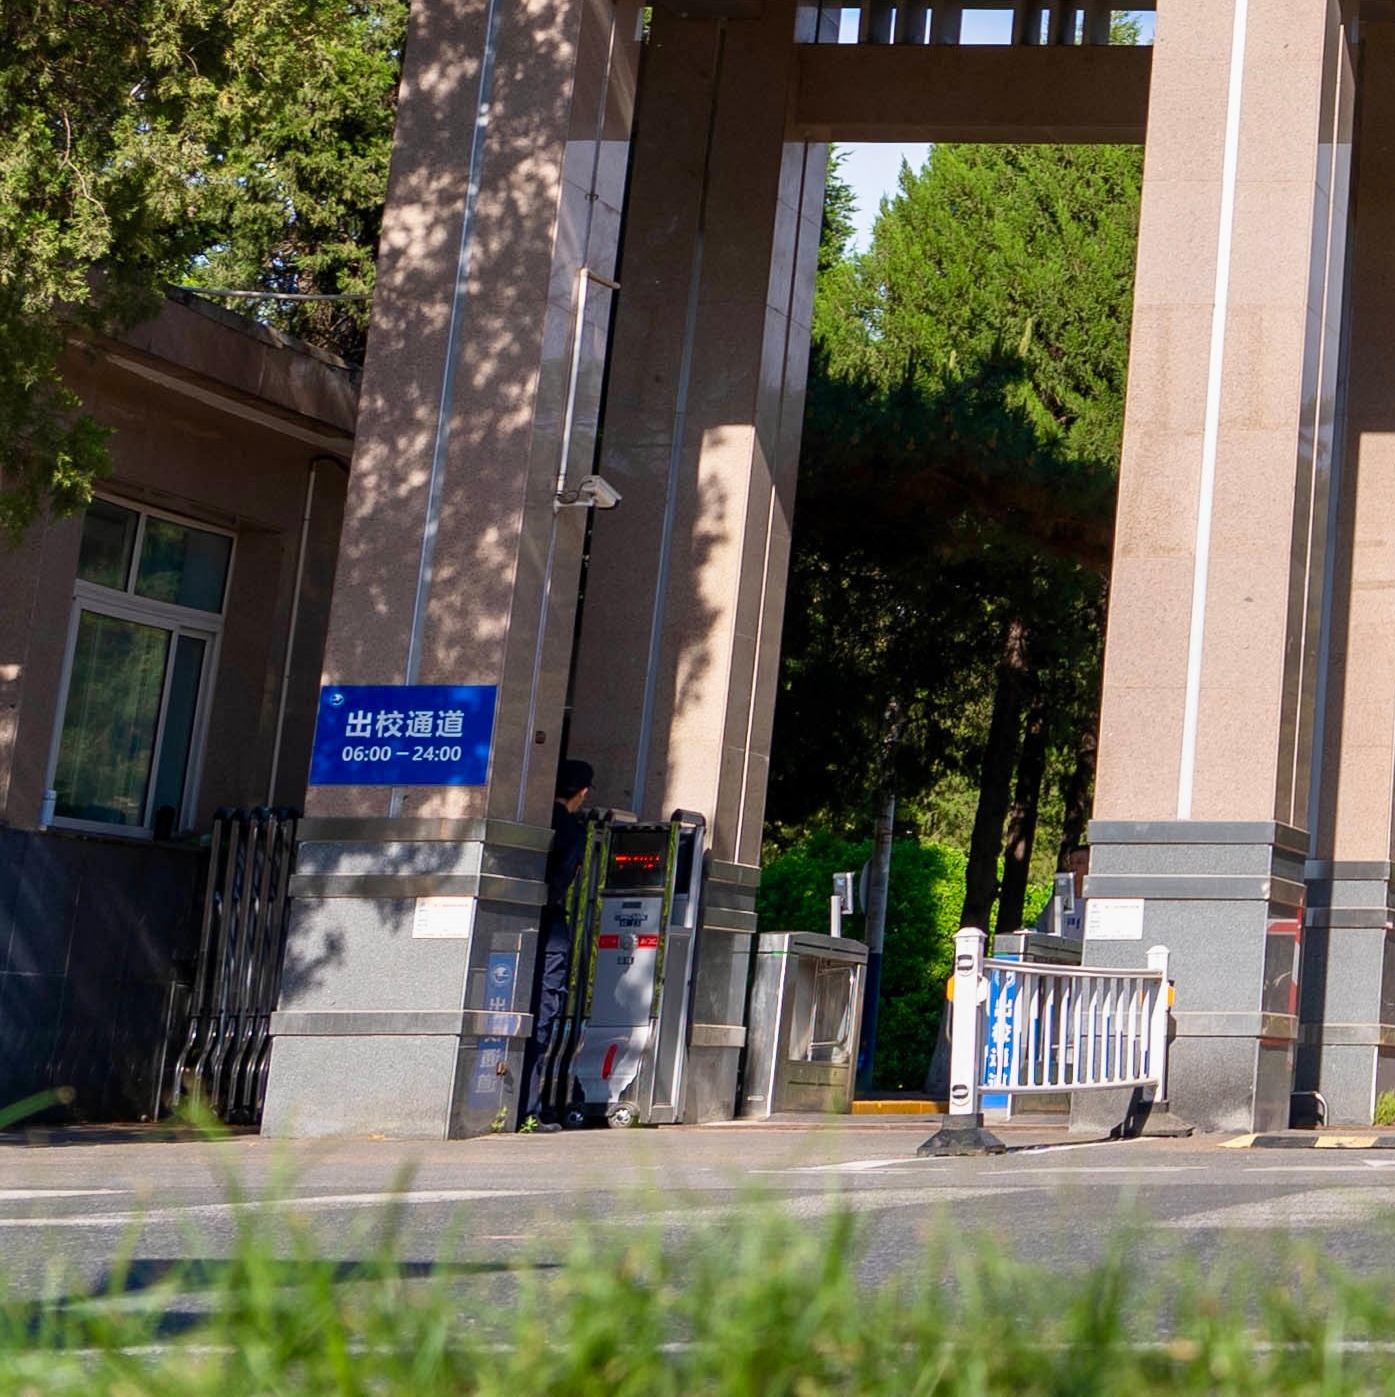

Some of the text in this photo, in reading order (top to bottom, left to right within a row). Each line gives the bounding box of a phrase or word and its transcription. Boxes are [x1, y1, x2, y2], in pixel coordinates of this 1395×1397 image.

[345, 710, 464, 738] 出校通道
[342, 746, 392, 761] 06:00
[412, 746, 462, 761] 24:00
